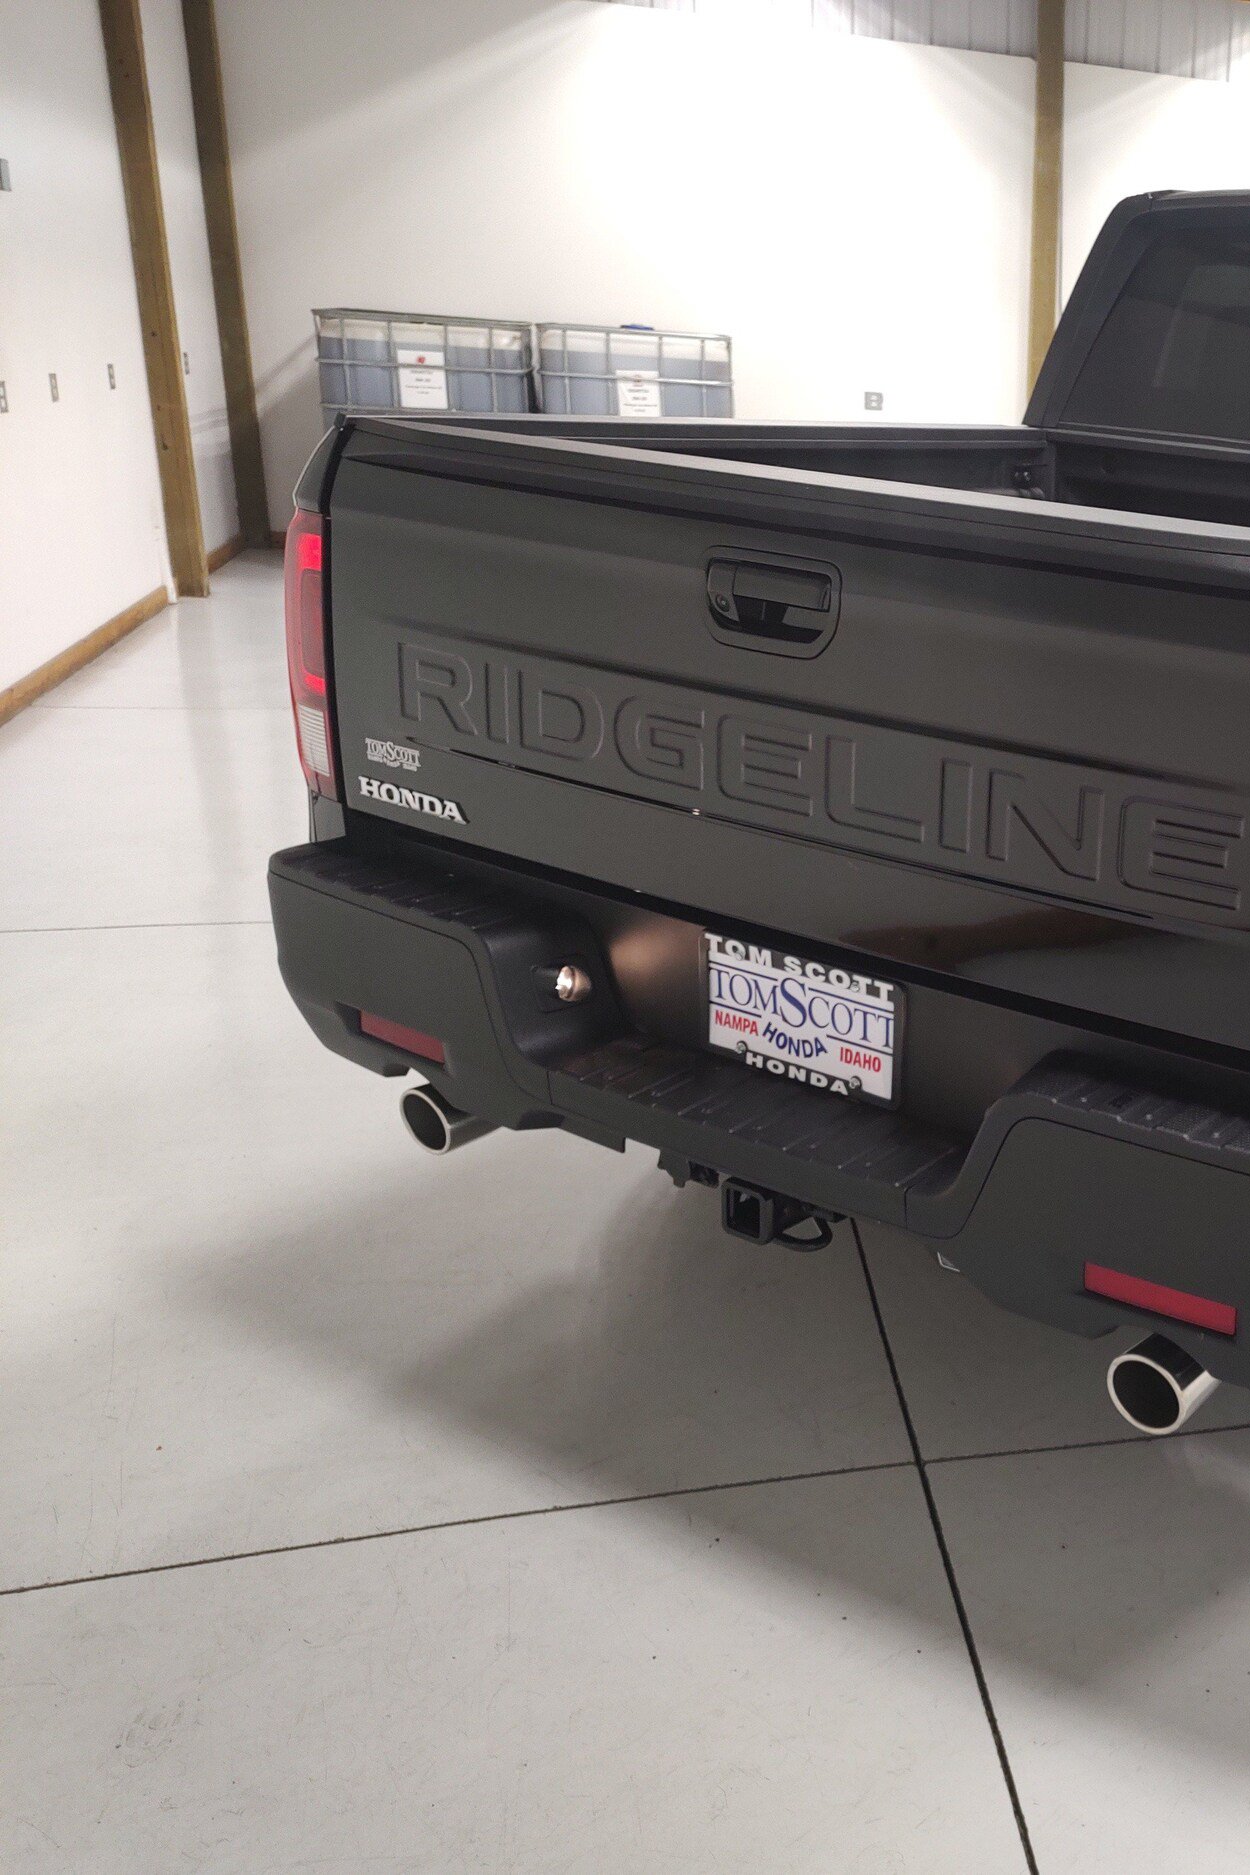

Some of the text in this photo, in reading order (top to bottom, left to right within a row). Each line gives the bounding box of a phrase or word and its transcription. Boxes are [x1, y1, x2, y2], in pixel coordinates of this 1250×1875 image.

[358, 776, 467, 825] HONDA
[398, 641, 1245, 910] RIDGELINE
[704, 932, 894, 1001] TOM SCOTT
[715, 1009, 881, 1072] NAMPA HONDA IDAHO
[745, 1051, 849, 1095] HONDA
